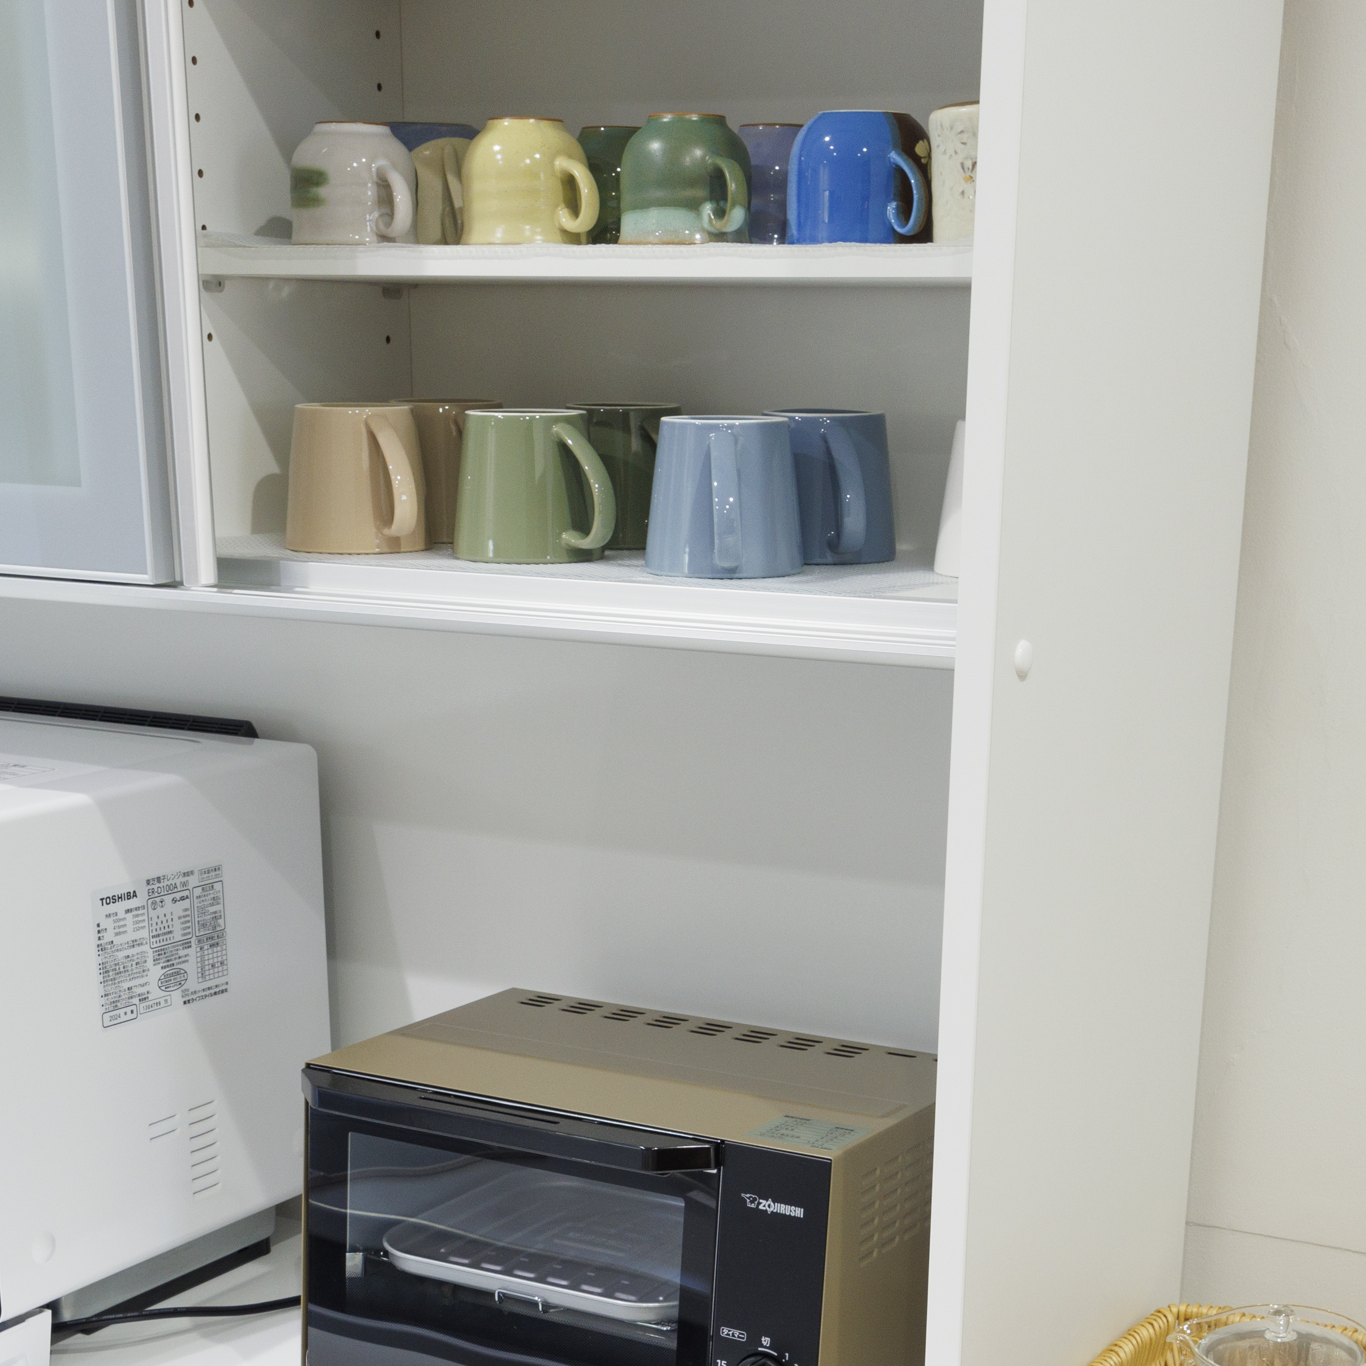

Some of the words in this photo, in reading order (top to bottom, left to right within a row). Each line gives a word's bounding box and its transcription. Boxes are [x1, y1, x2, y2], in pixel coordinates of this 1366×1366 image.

[147, 882, 179, 897] ER-D100A
[179, 879, 190, 889] (W)
[99, 890, 138, 907] TOSHIBA
[108, 1012, 121, 1023] 2024
[758, 1198, 804, 1219] ZOJIRUSHI
[721, 1327, 745, 1340] タイマー
[761, 1335, 771, 1347] 切
[784, 1353, 789, 1361] 1
